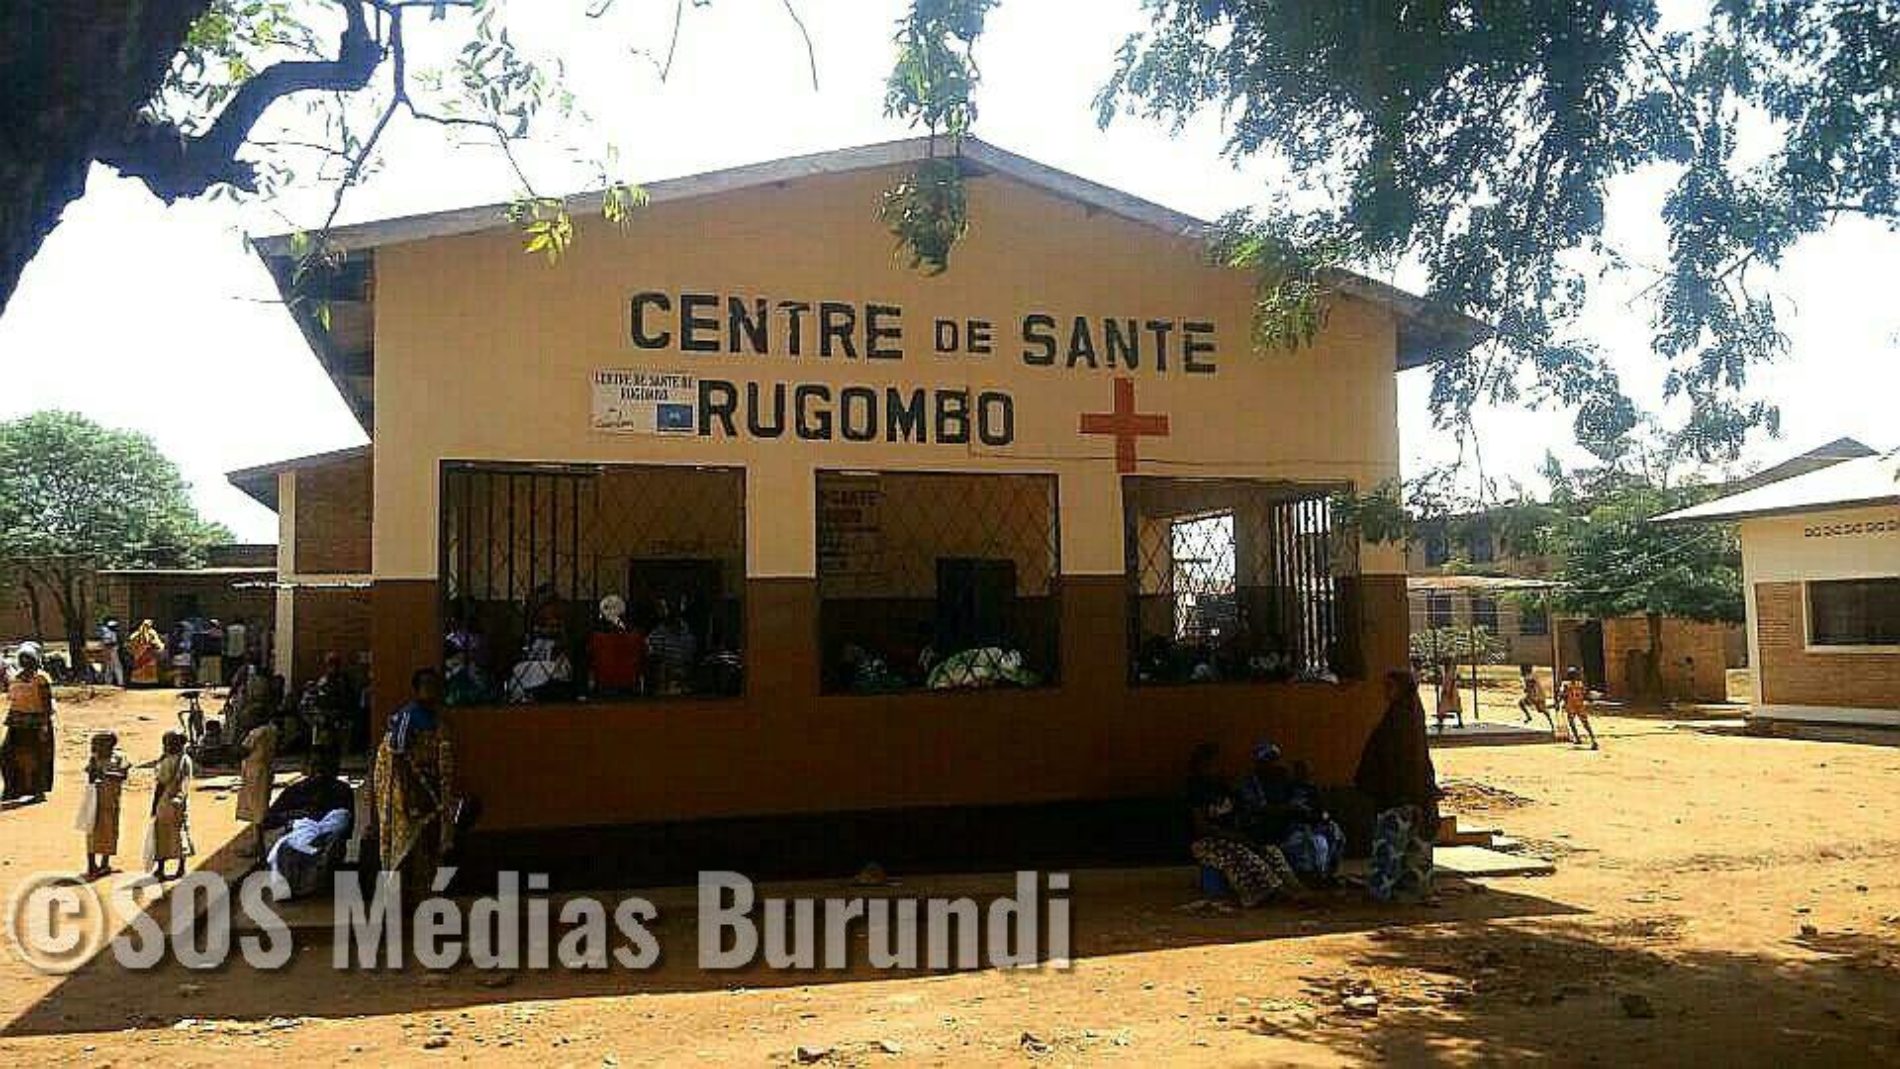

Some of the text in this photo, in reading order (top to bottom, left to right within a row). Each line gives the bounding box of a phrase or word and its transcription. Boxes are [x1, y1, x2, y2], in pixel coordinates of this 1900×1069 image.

[630, 291, 1217, 374] CENTRE DE SANTE
[698, 378, 1015, 446] RUGOMBO
